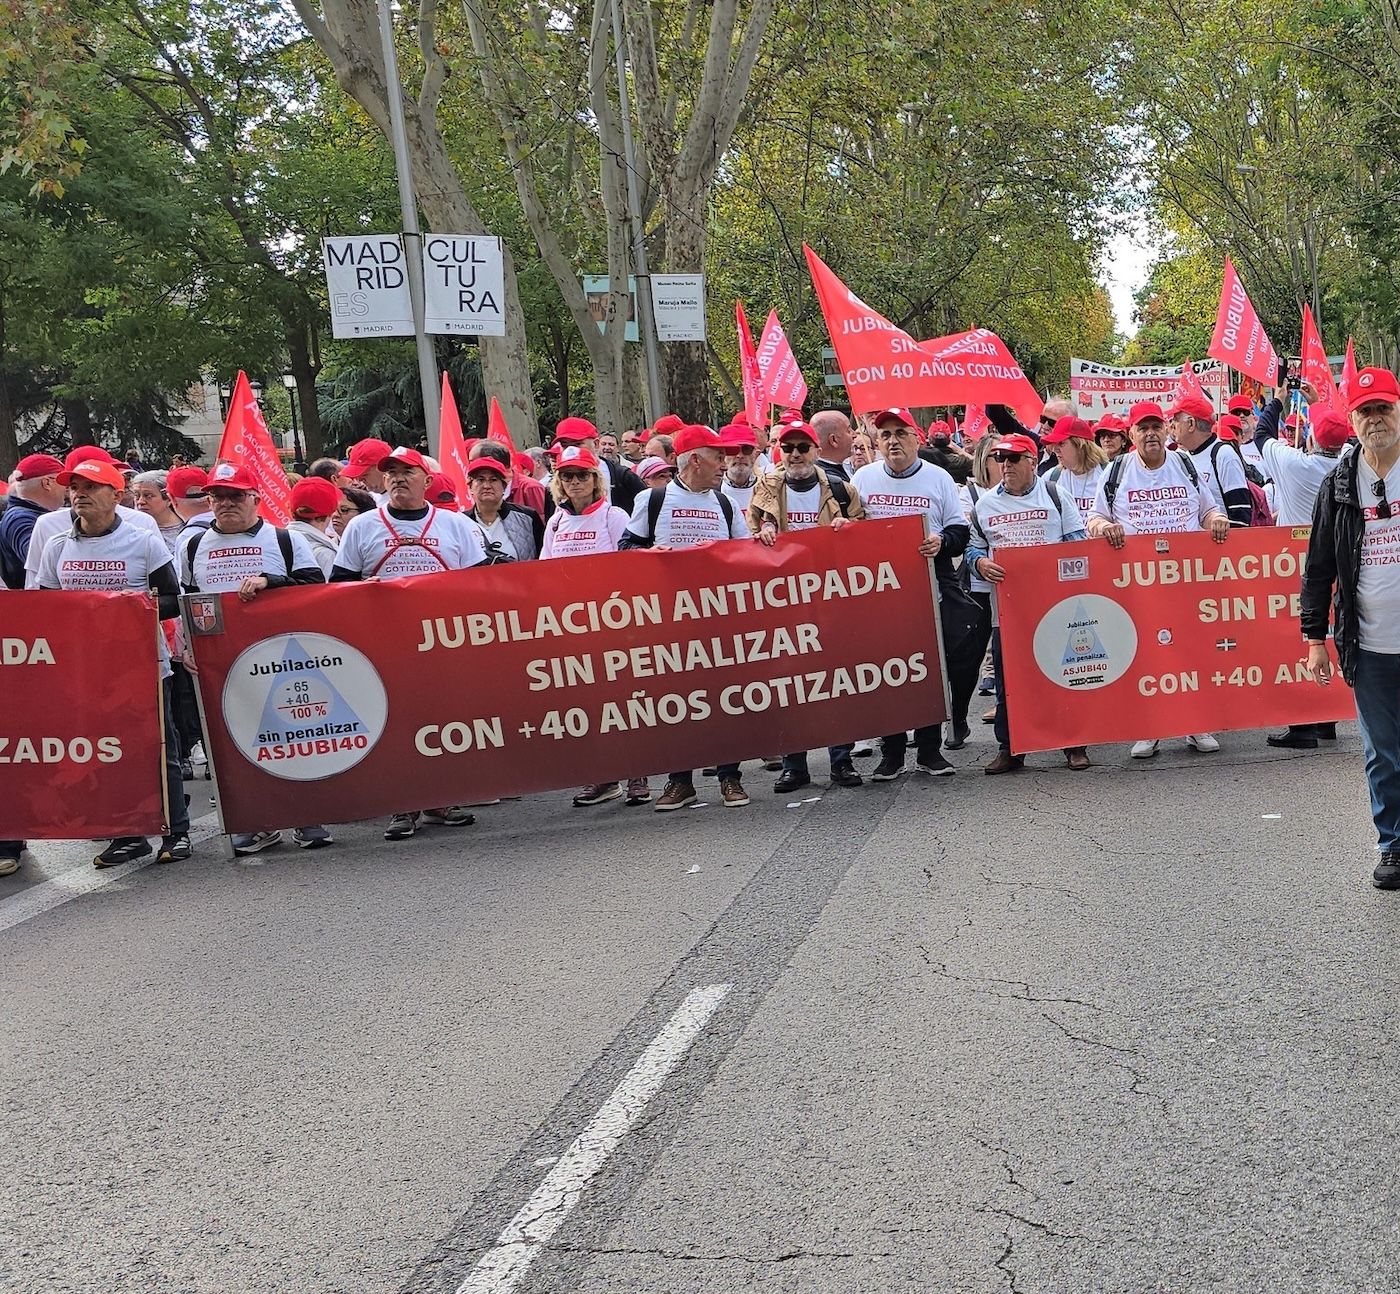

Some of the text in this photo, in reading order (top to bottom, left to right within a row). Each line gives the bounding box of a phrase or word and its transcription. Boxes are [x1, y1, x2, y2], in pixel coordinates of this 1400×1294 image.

[326, 241, 401, 267] MAD
[427, 239, 487, 263] CUL
[356, 266, 404, 290] RID
[436, 264, 476, 288] TU
[333, 291, 370, 318] ES
[458, 290, 500, 314] RA
[454, 323, 484, 331] MADRID
[846, 365, 886, 386] CON
[891, 362, 914, 379] 40
[1079, 378, 1165, 390] PARA EL PUEBLO
[869, 495, 929, 507] ASJUBI40
[1130, 487, 1186, 502] ASJUBI40
[991, 510, 1047, 526] ASJUBI40
[555, 532, 595, 541] ASJUBI40
[210, 547, 260, 559] ASJUBI40
[63, 561, 124, 572] ASJUBI40
[417, 561, 901, 652] JUBILACIÓN ANTICIPADA
[1198, 596, 1256, 623] SIN
[1066, 619, 1099, 629] Jubilación
[249, 654, 344, 677] Jubilación
[526, 623, 823, 692] SIN PENALIZAR
[1062, 663, 1108, 677] ASJUBI40
[1138, 670, 1199, 697] CON
[1211, 665, 1263, 687] +40
[290, 704, 327, 719] 100 %
[414, 652, 928, 757] CON +40 AÑOS COTIZADOS
[258, 720, 360, 744] sin penalizar
[256, 734, 368, 762] ASJUBI40
